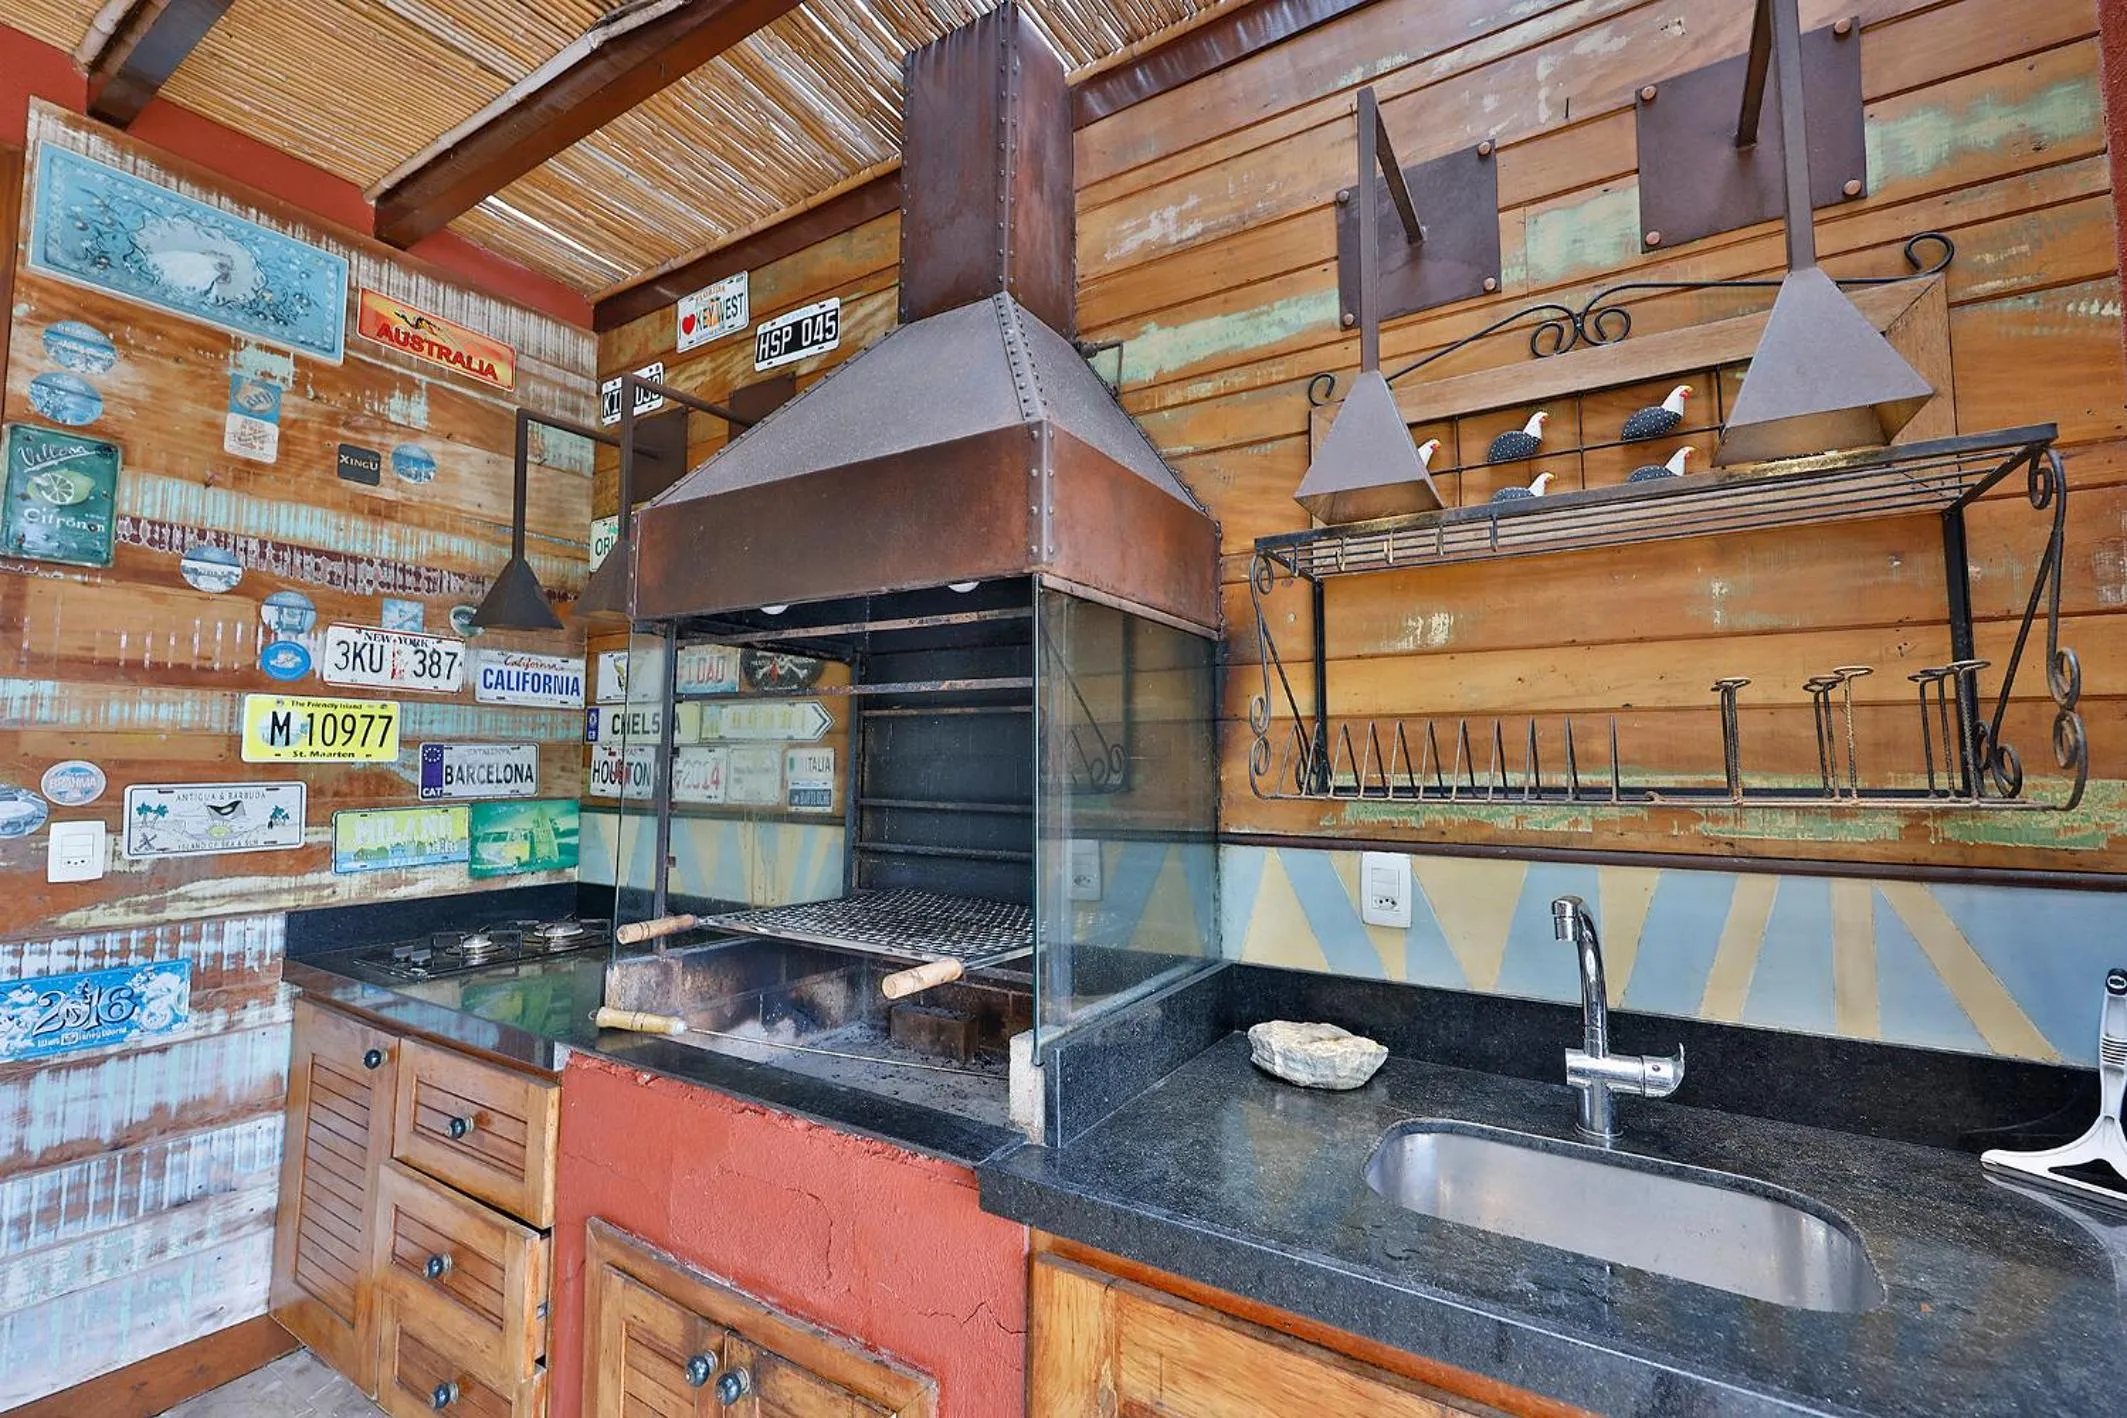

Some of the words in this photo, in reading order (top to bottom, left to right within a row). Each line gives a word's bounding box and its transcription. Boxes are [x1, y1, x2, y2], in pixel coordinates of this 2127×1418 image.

[758, 326, 792, 362] HSP
[801, 310, 837, 347] 045
[376, 322, 499, 381] AUSTRALIA
[339, 454, 379, 472] XINGU
[363, 631, 392, 644] NEW
[397, 634, 430, 649] YORK
[333, 640, 385, 673] 3KU
[413, 648, 459, 681] 387
[482, 667, 581, 697] CALIFORNIA
[291, 700, 305, 708] The
[307, 701, 338, 710] Friendly
[270, 711, 292, 747] M
[307, 712, 394, 748] 10977
[612, 711, 682, 736] CHELSA
[292, 750, 307, 758] St.
[444, 763, 535, 786] BARCELONA
[592, 759, 651, 787] HOUSTON
[422, 787, 443, 797] CAT
[32, 985, 138, 1038] 2016
